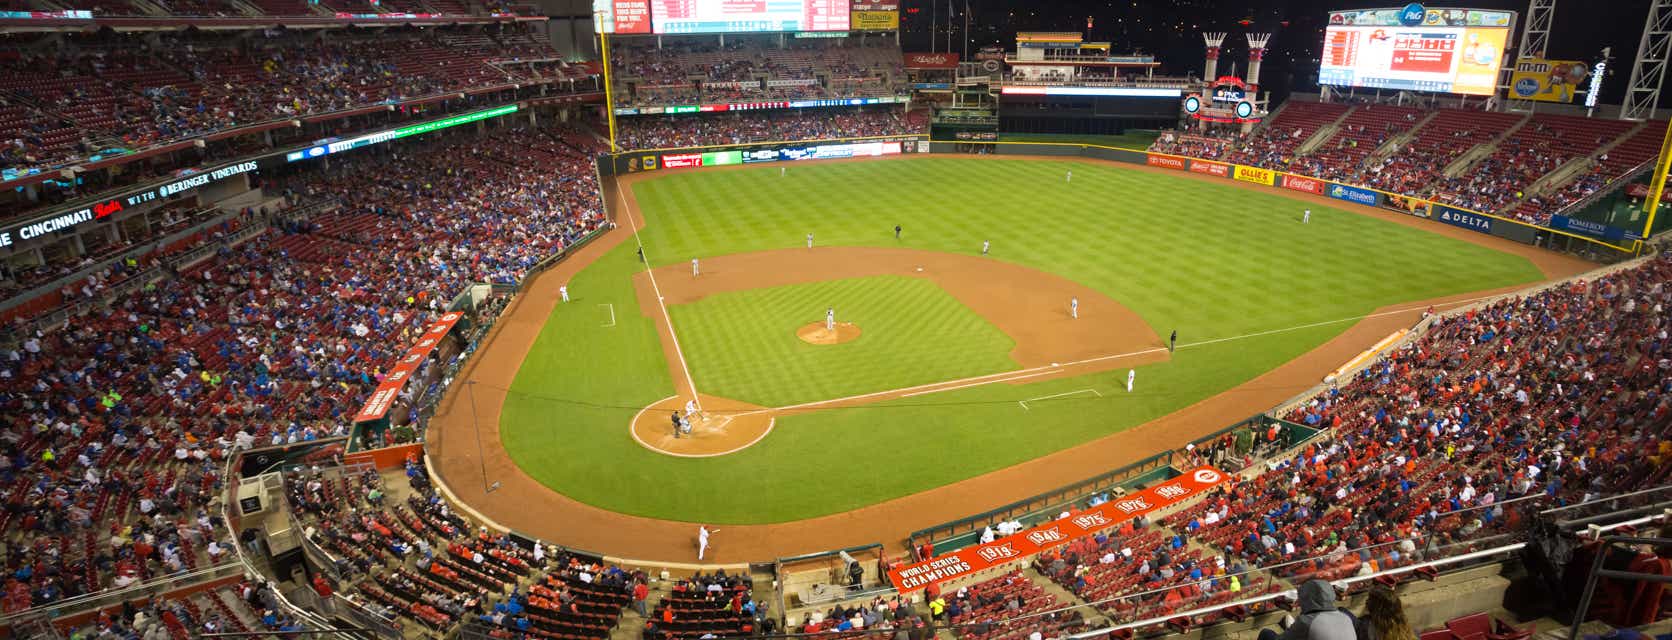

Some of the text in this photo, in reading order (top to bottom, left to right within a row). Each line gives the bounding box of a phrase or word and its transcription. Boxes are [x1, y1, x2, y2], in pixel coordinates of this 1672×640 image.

[1405, 11, 1421, 20] P&G
[1224, 91, 1239, 99] PNC
[1160, 158, 1182, 167] TOYOTA
[20, 209, 92, 240] CINCINNATI
[128, 191, 155, 206] WITH
[167, 174, 209, 194] BERINGER
[211, 161, 258, 180] VINEYARDS
[1453, 213, 1489, 229] DELTA
[981, 546, 1012, 560] 1919
[1030, 528, 1060, 544] 1940
[1076, 513, 1105, 529] 1975
[899, 555, 961, 578] WORLD SERIES
[902, 561, 971, 588] CHAMPIONS
